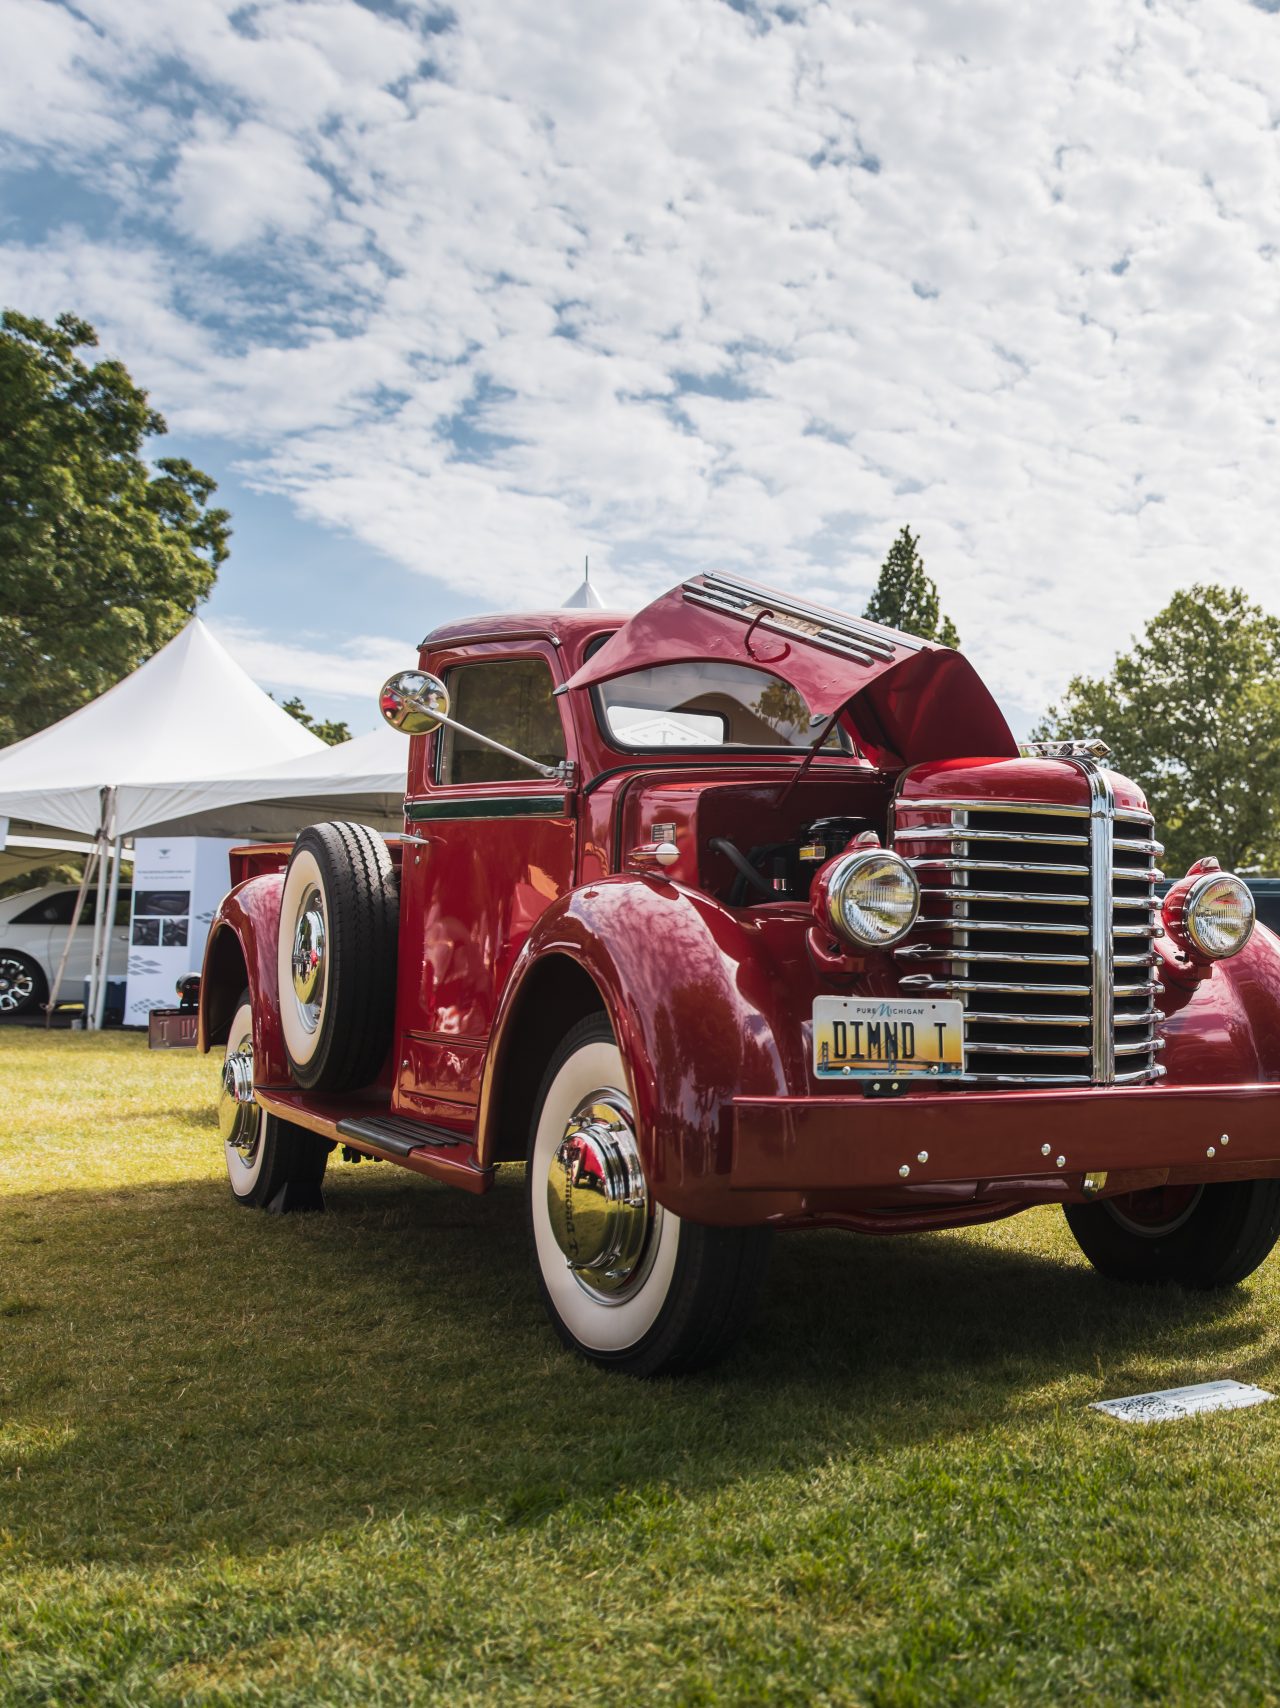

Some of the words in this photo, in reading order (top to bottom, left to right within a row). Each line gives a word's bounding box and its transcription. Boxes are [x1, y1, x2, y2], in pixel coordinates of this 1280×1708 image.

[856, 1007, 877, 1015] PURE
[874, 1003, 924, 1017] MICHIGAN
[832, 1020, 915, 1060] DIMND
[933, 1022, 947, 1060] T
